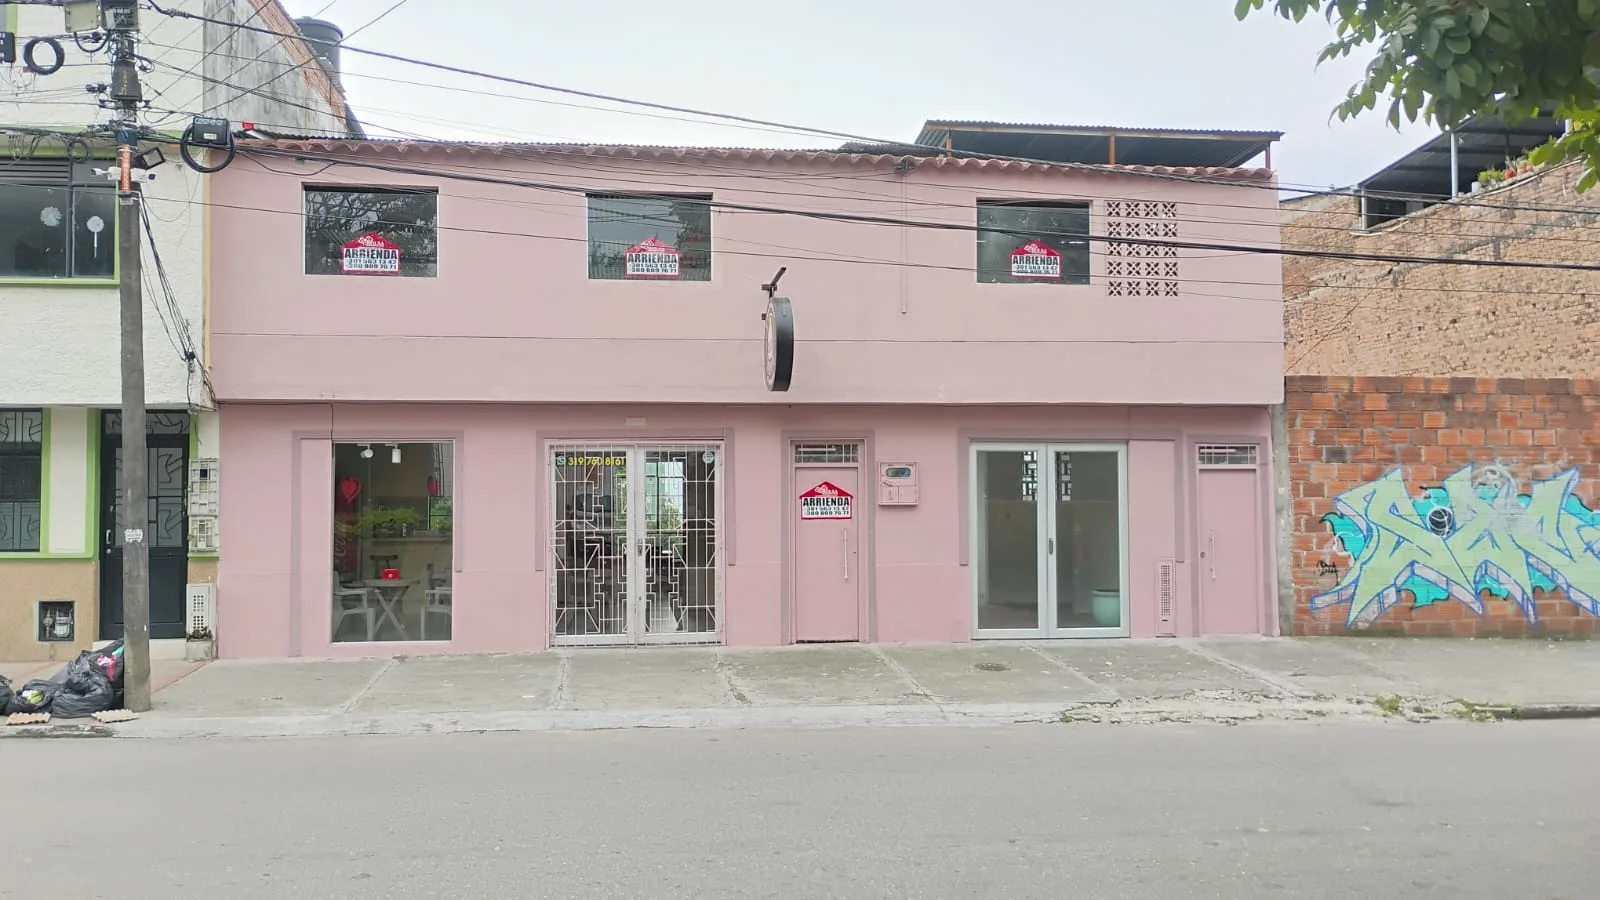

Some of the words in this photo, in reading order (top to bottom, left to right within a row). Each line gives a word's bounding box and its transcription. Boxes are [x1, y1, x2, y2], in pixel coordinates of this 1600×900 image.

[345, 249, 397, 259] ARRIENDA
[628, 254, 677, 264] ARRIENDA
[1013, 256, 1058, 265] ARRIENDA
[568, 456, 584, 466] 319
[587, 456, 603, 466] 760
[605, 456, 625, 466] 8161
[803, 498, 849, 506] ARRIENDA
